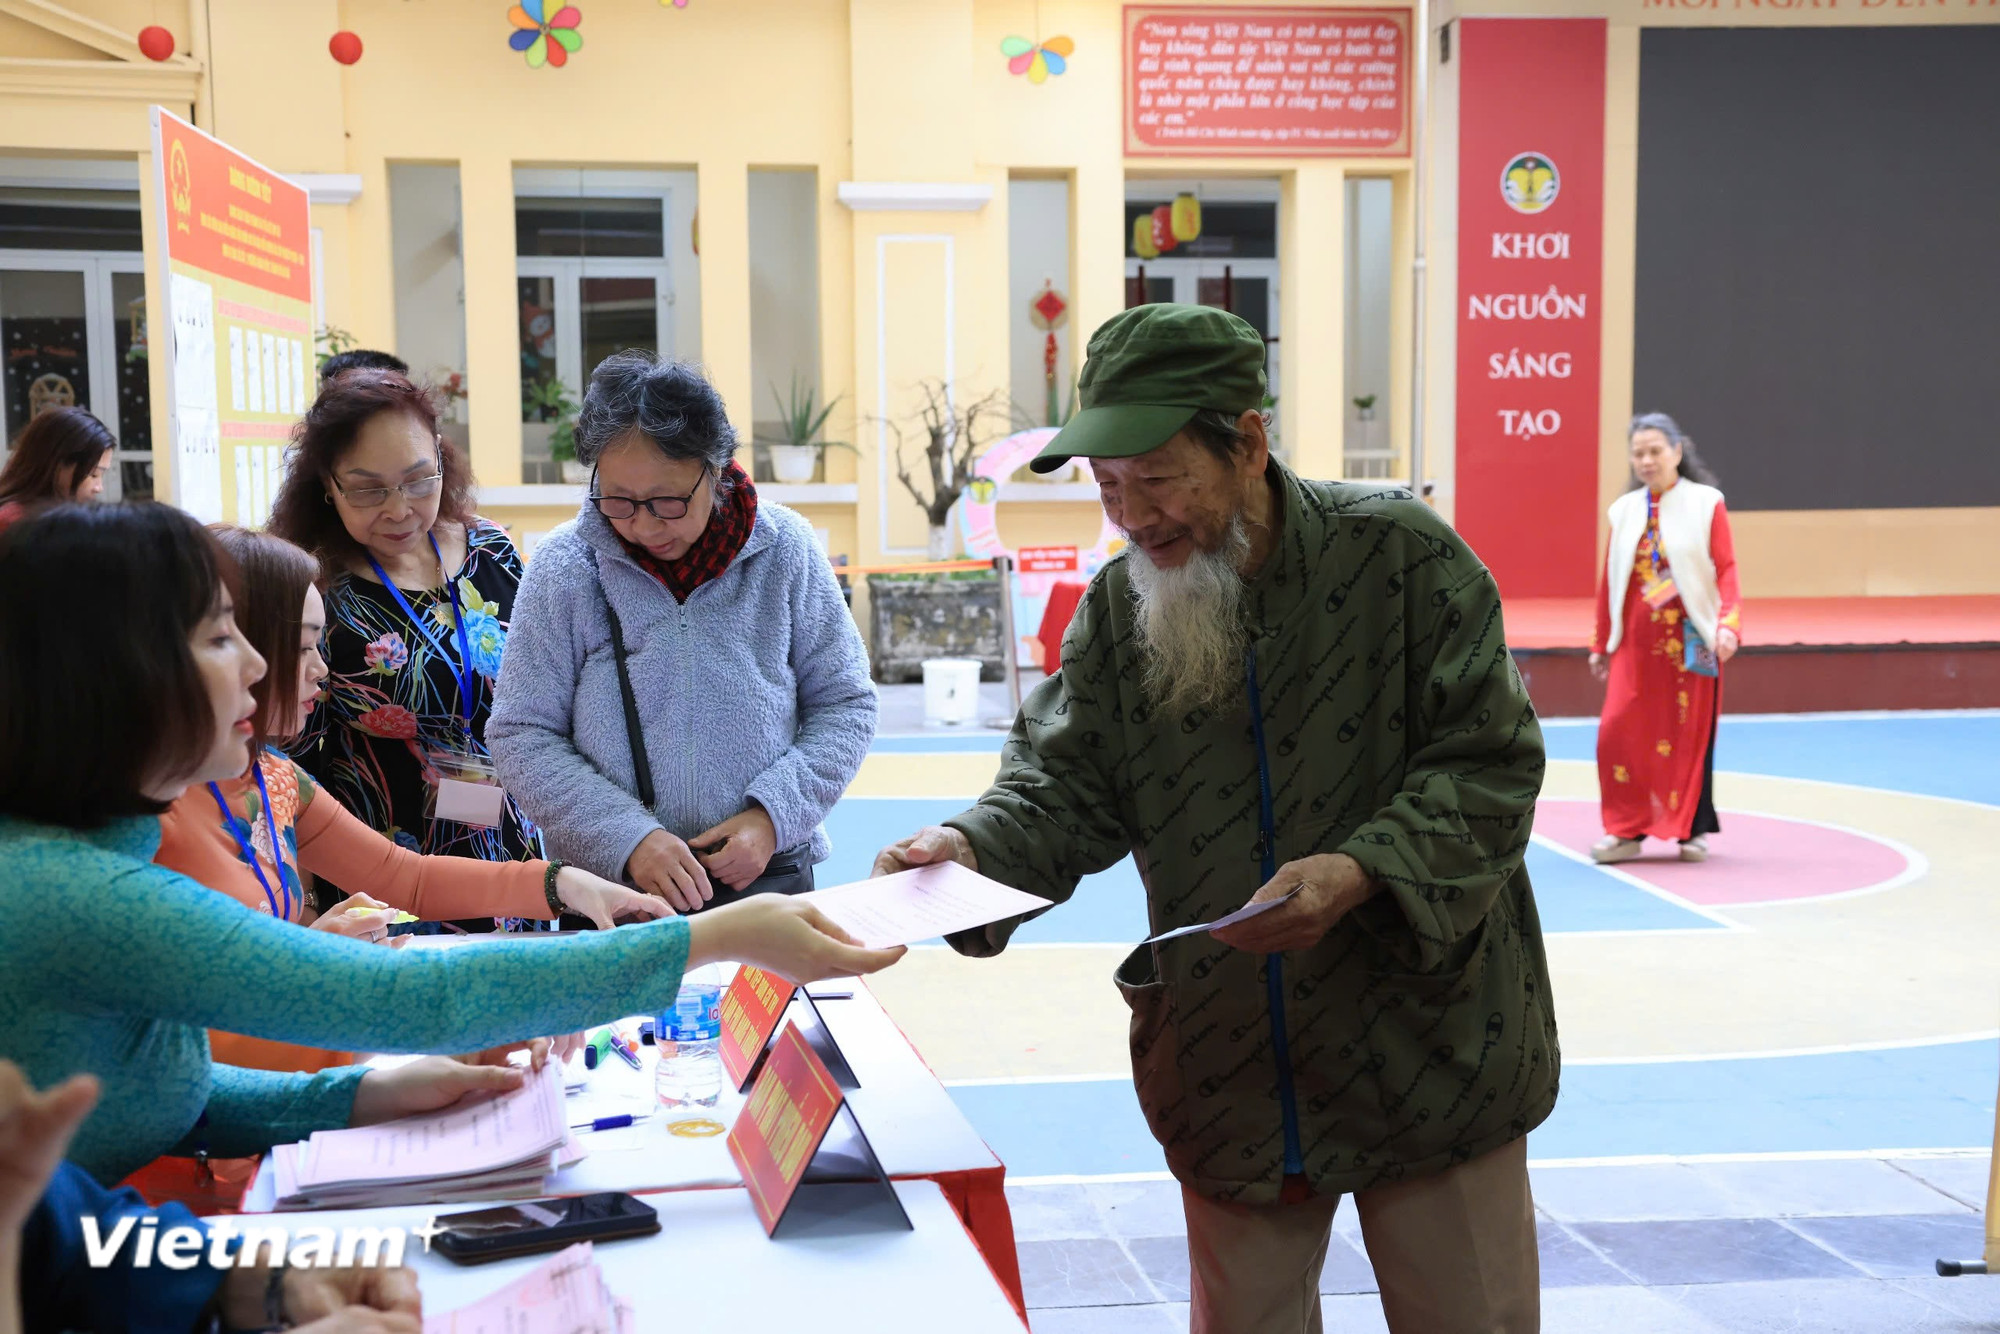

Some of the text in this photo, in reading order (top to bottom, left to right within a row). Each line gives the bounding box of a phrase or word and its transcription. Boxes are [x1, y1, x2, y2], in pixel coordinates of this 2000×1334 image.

[1491, 231, 1570, 259] KHƠI
[1468, 284, 1587, 320] NGUỒN
[1488, 348, 1572, 380] SÁNG
[1497, 409, 1561, 440] TẠO
